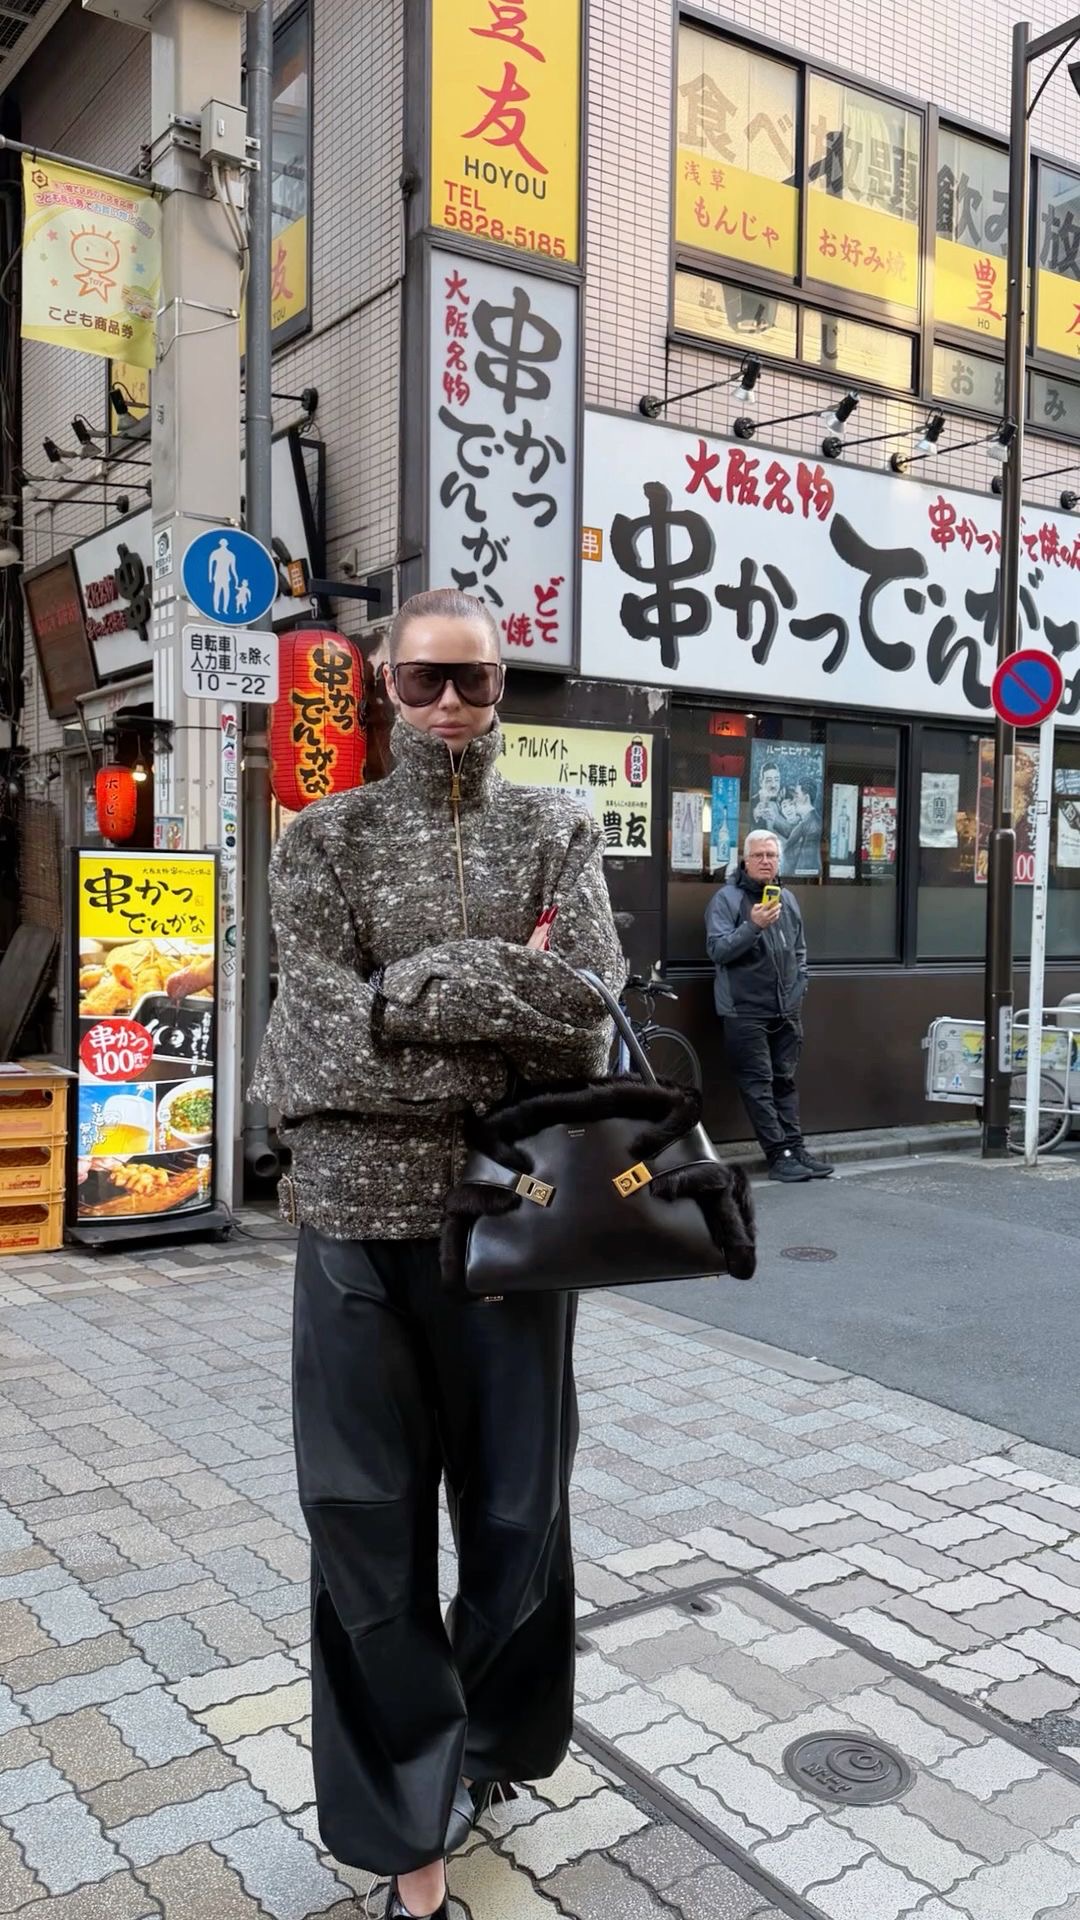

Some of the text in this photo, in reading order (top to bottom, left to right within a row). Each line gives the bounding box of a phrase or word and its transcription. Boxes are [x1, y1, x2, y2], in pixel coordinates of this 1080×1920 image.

[443, 181, 487, 212] TEL
[464, 156, 547, 200] HOYOU
[684, 161, 726, 191] 浅草
[443, 205, 566, 259] 5828-5185
[694, 196, 780, 248] もんじゃ
[48, 306, 134, 340] こども商品券
[443, 270, 470, 406] 大阪名物
[472, 286, 566, 529] 串かつ
[685, 438, 836, 521] 大阪名物
[581, 530, 599, 560] 串
[534, 576, 565, 644] どて
[190, 633, 271, 666] 自転車 を除く
[190, 651, 232, 671] 人力車
[312, 640, 356, 731] 串かつ
[292, 691, 334, 796] でんがな
[559, 763, 618, 788] パート募集中
[603, 810, 647, 848] 豊友
[84, 867, 193, 913] 串かつ
[120, 909, 205, 935] でんがな
[88, 1024, 149, 1053] 串かつ
